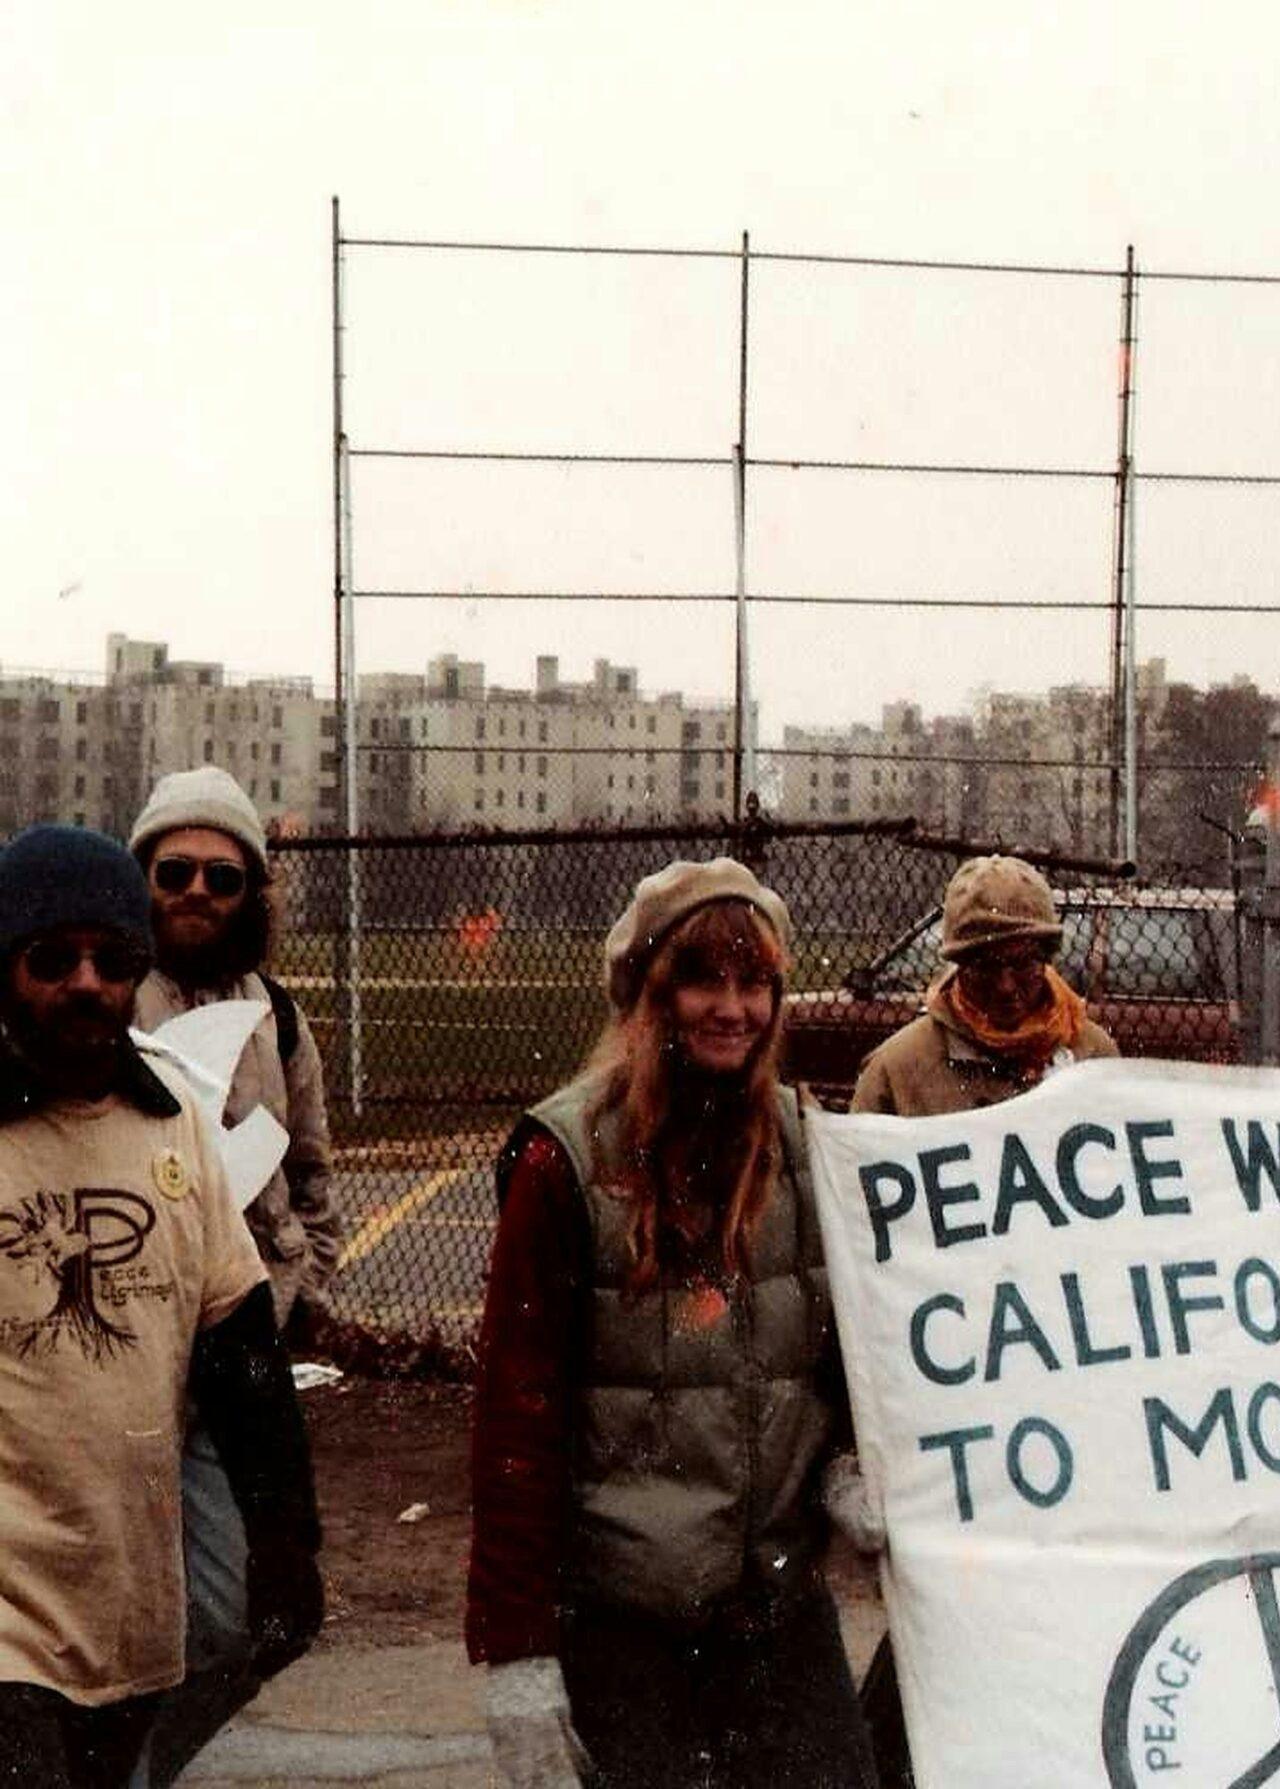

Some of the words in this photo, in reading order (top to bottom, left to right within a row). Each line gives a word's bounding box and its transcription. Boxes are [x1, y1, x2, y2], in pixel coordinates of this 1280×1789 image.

[858, 1119, 1192, 1263] PEACE
[918, 1416, 1074, 1523] TO
[1143, 1636, 1203, 1773] PEACE
